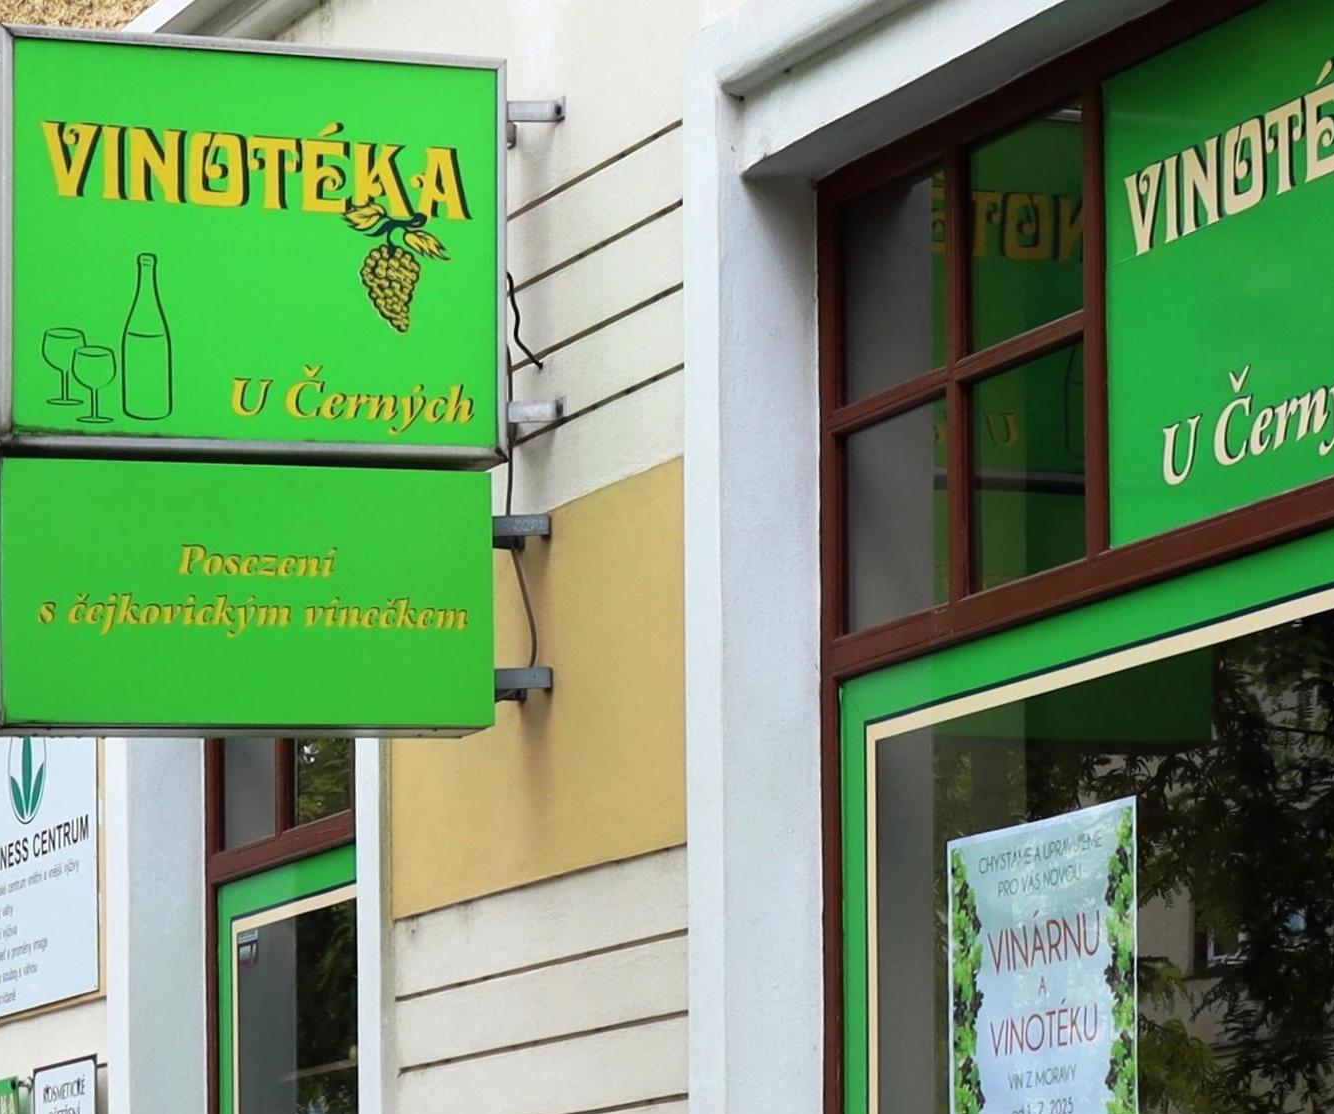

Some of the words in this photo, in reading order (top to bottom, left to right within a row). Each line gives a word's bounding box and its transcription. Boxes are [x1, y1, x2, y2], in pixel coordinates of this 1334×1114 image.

[41, 121, 473, 221] VINOTÉKA
[231, 377, 271, 418] U
[285, 364, 475, 436] Černých
[1162, 415, 1200, 486] U
[177, 542, 337, 578] Posezení
[38, 600, 57, 626] s
[68, 594, 293, 639] čejkovickým
[32, 814, 90, 858] CENTRUM
[997, 878, 1020, 898] PRO
[986, 909, 1102, 975] VINÁRNU
[1037, 976, 1048, 997] A
[989, 999, 1100, 1059] VINOTÉKU
[1026, 1070, 1033, 1088] Z
[1035, 1063, 1077, 1087] MORAVY
